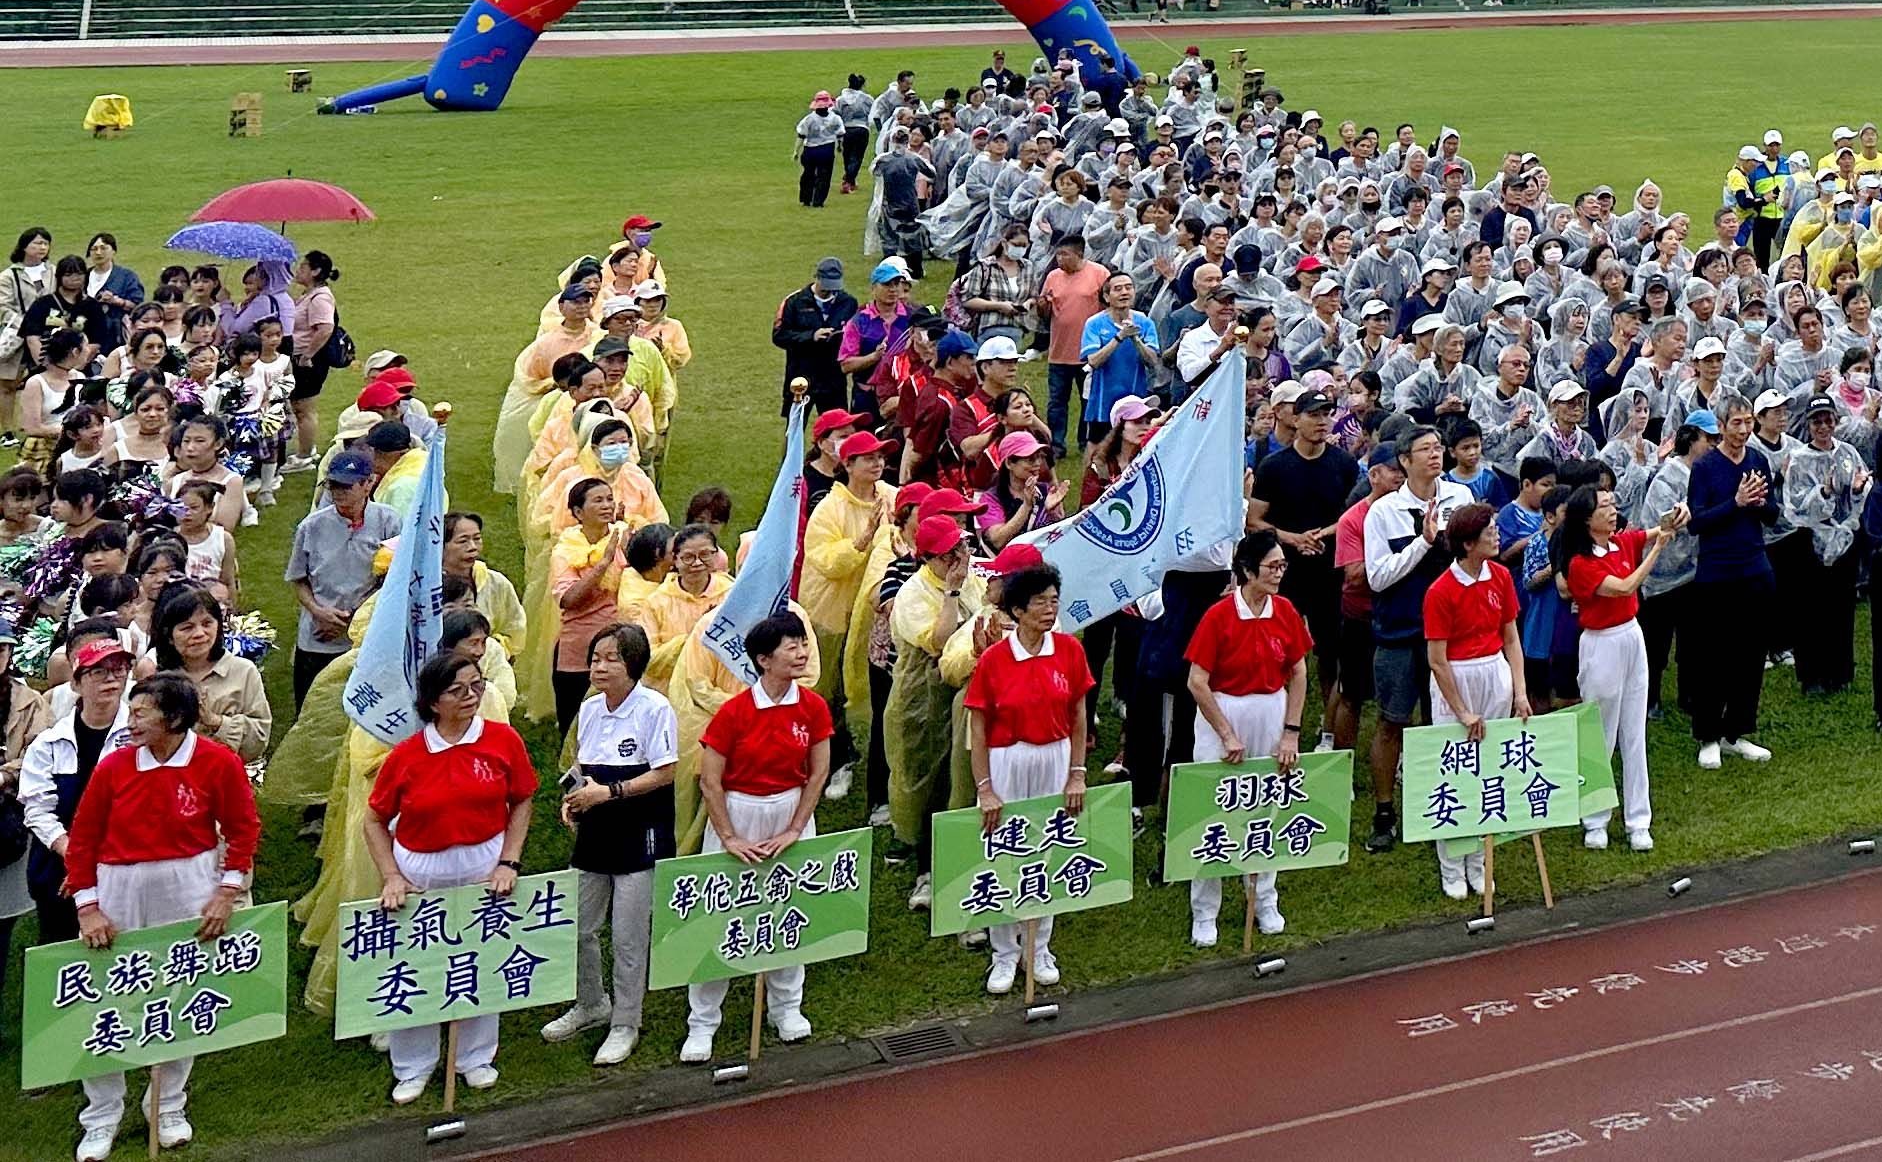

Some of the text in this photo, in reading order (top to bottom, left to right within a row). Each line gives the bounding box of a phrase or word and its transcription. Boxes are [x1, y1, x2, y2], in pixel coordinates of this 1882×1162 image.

[1440, 730, 1543, 776] 網球
[1215, 769, 1308, 812] 羽球
[1422, 772, 1561, 830] 委員會
[982, 808, 1087, 860] 健走
[1191, 814, 1326, 864] 委員會
[669, 851, 860, 919] 華佗五禽之戲
[960, 854, 1106, 914] 委員會
[341, 880, 575, 961] 攝氣養生
[719, 912, 809, 960] 委員會
[54, 931, 262, 1008] 民族舞蹈
[366, 944, 550, 1017] 委員會
[85, 989, 231, 1054] 委員會
